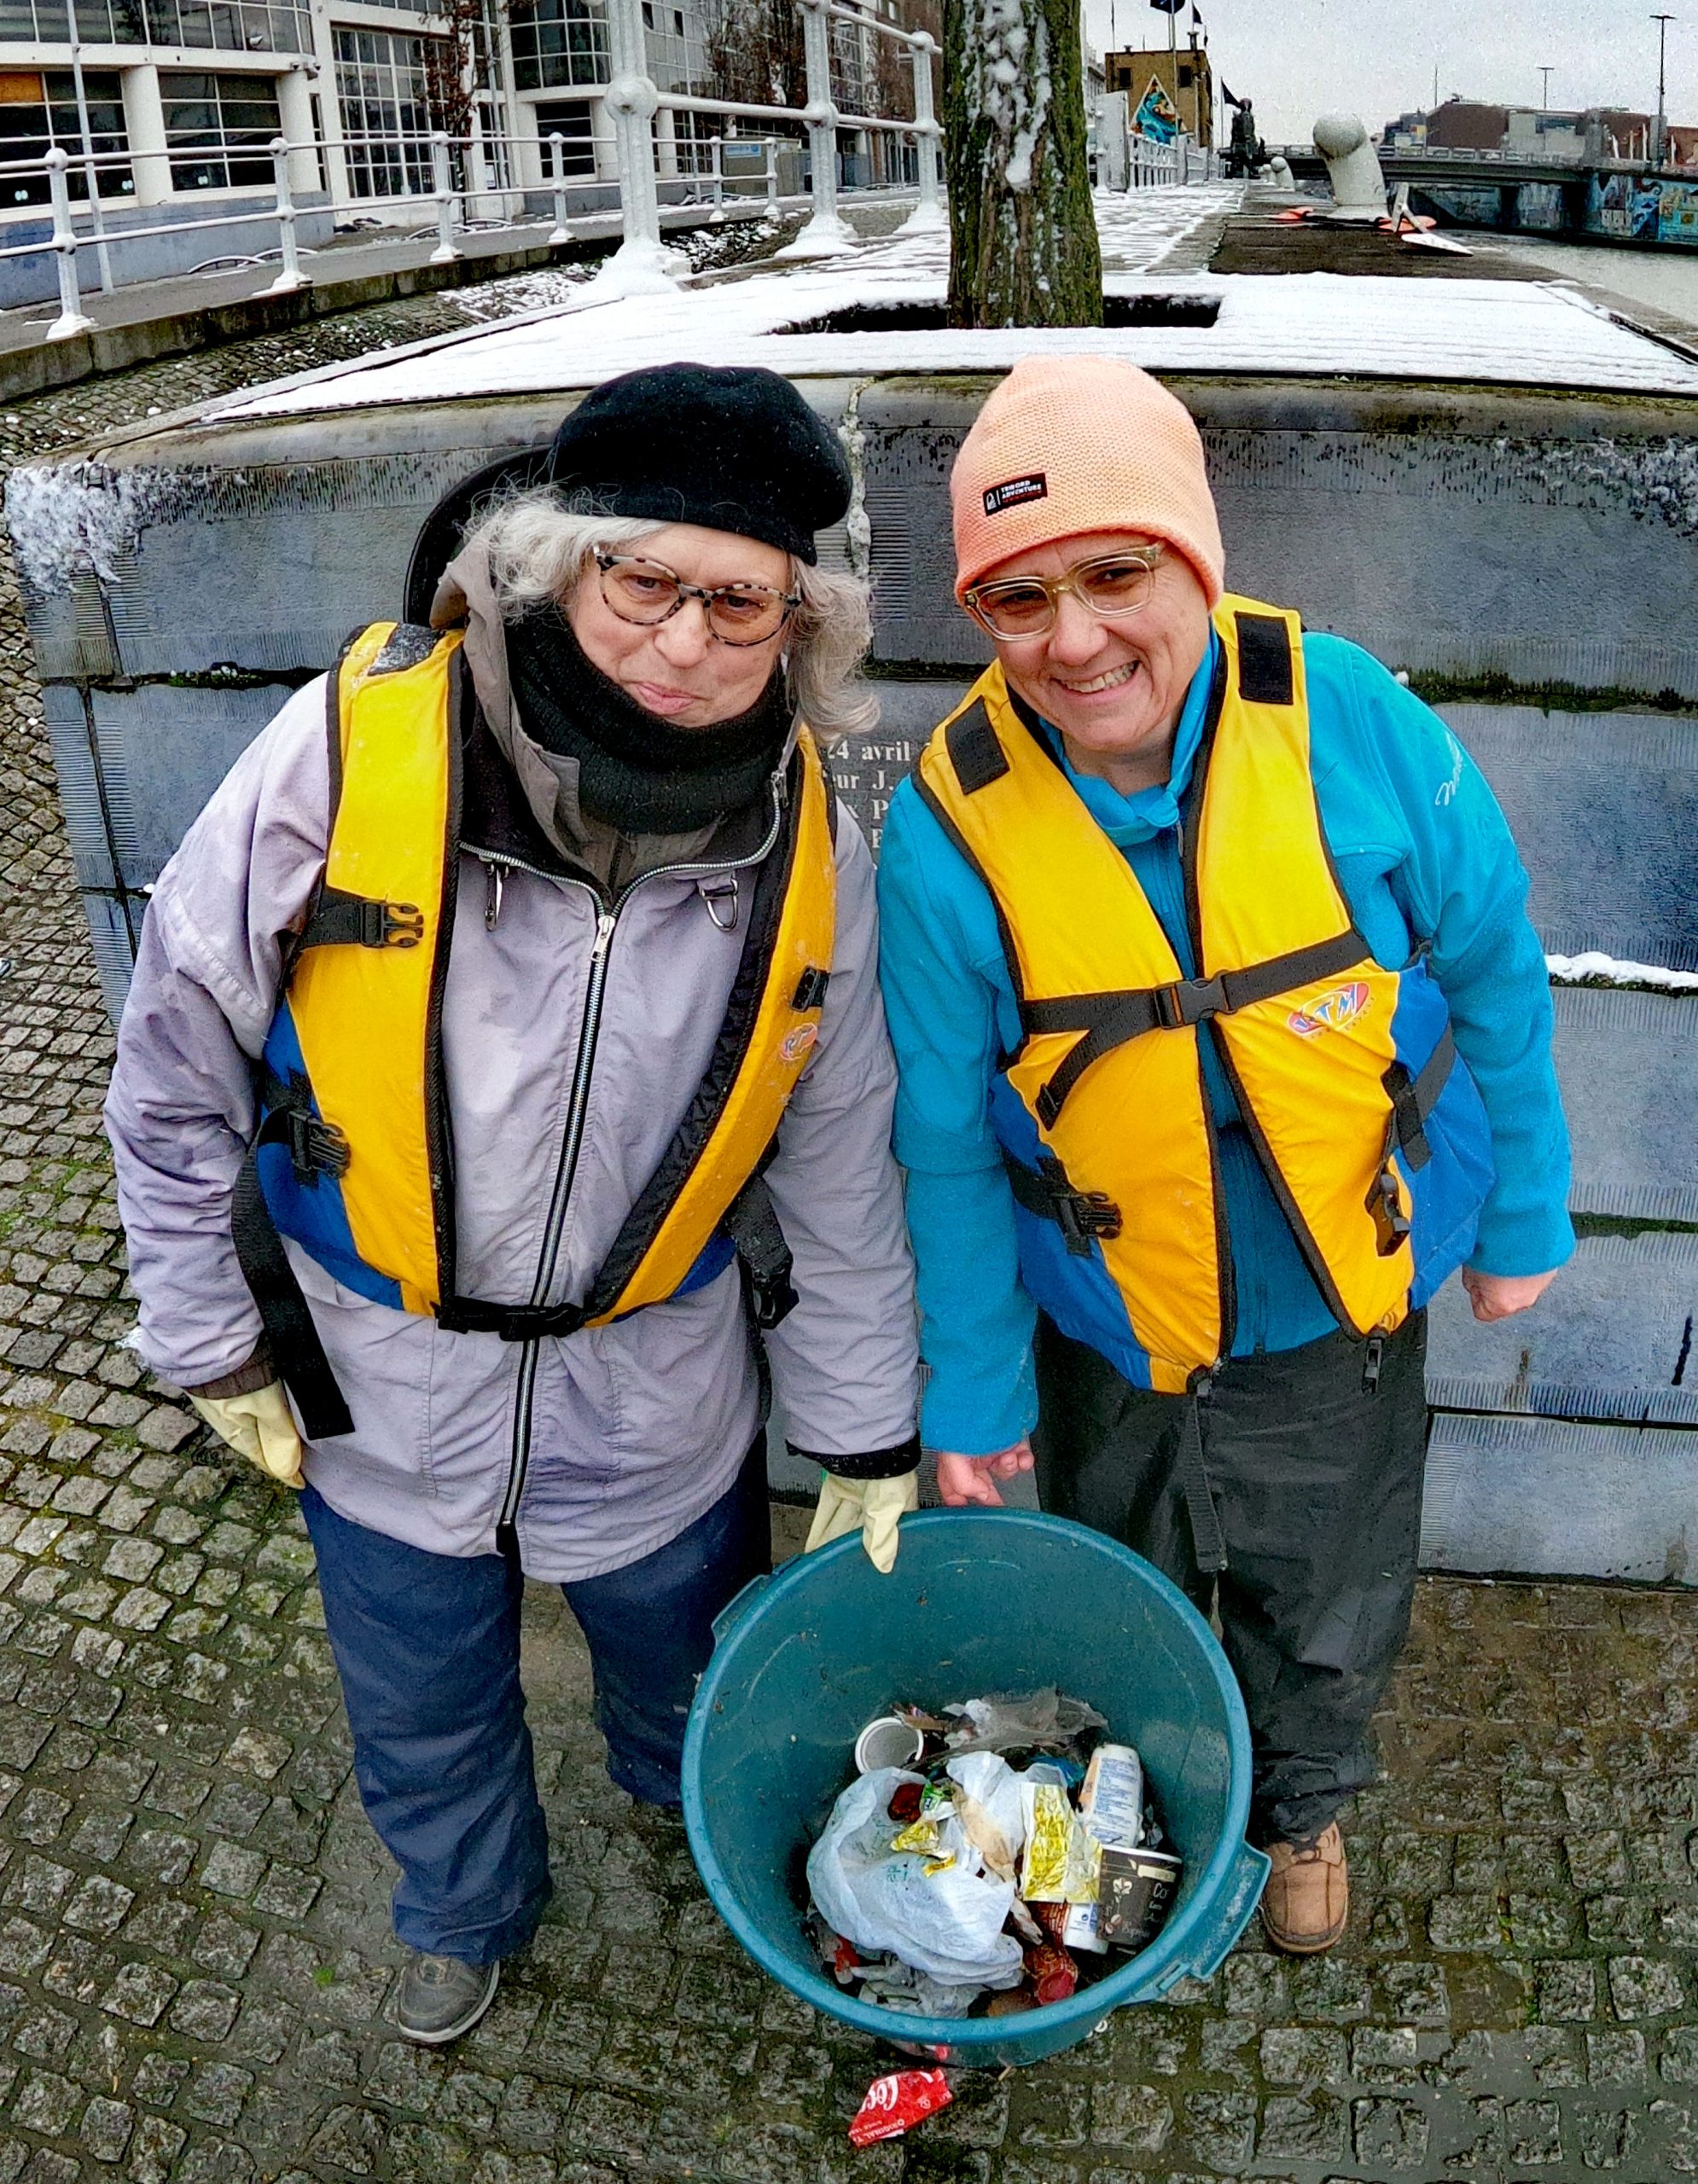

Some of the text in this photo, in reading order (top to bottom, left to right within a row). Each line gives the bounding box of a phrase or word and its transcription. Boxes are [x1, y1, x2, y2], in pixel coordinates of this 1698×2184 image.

[1002, 483, 1042, 499] ADVENTURE
[861, 741, 911, 762] avril
[872, 770, 894, 791] J.
[871, 799, 889, 820] P
[1153, 1882, 1169, 1899] Co
[864, 2118, 905, 2140] ORIGINAL
